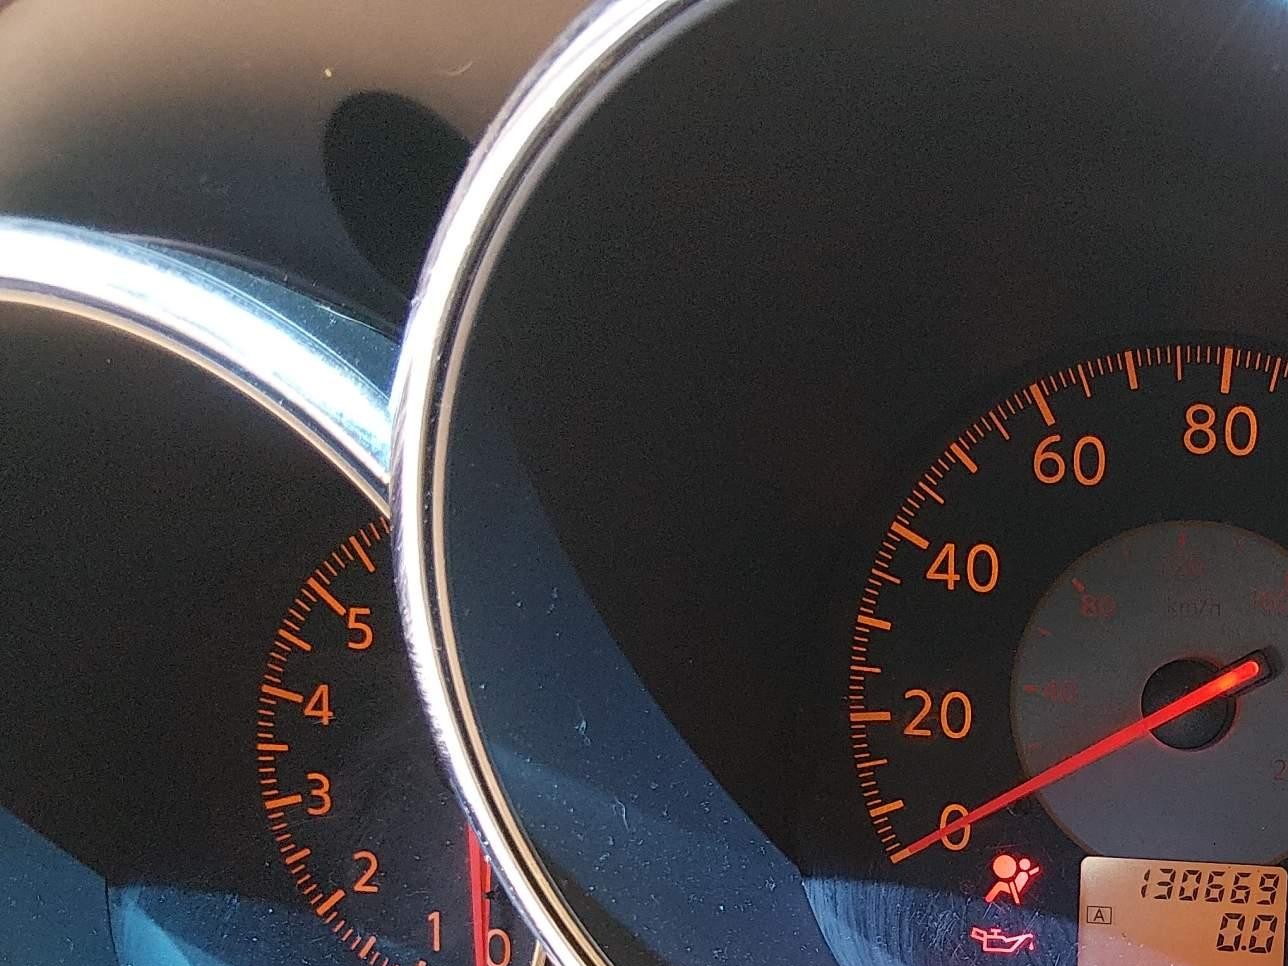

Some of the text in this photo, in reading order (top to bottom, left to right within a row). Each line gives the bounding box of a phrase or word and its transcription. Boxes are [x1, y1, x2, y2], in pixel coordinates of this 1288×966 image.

[1183, 403, 1258, 456] 80
[1032, 434, 1106, 486] 60
[925, 543, 999, 594] 40
[346, 607, 373, 650] 5
[303, 684, 333, 725] 4
[903, 689, 972, 739] 20
[306, 773, 332, 815] 3
[939, 804, 971, 851] 0
[353, 851, 378, 893] 2
[1140, 868, 1279, 905] 130669
[427, 911, 441, 952] 1
[1216, 912, 1278, 953] 0.0
